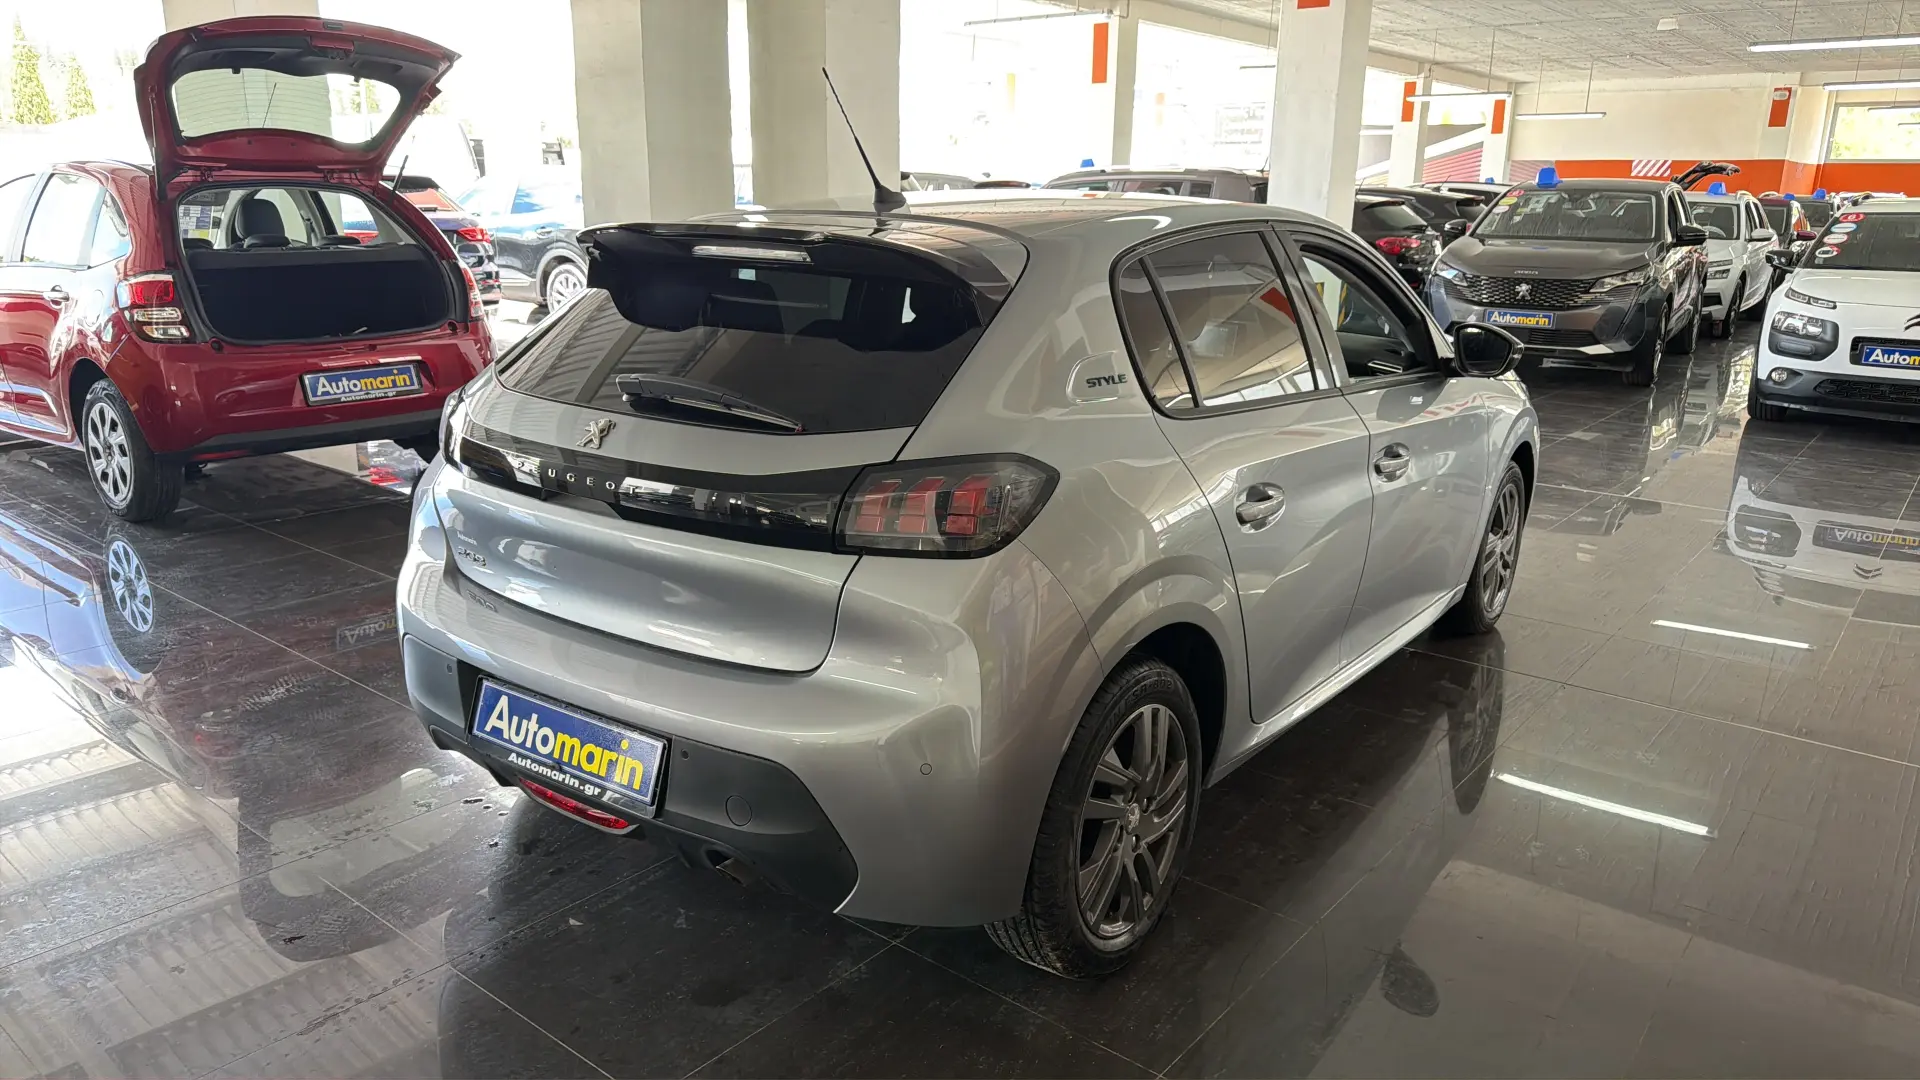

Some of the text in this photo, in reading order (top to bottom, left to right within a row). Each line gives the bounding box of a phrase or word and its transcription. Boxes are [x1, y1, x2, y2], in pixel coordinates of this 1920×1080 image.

[1490, 311, 1549, 326] Automarin
[317, 369, 411, 396] Automarin
[1086, 373, 1128, 388] STYLE
[341, 391, 397, 402] Automarin.gr
[516, 460, 638, 495] PEUGEOT
[484, 694, 644, 790] Automarin
[508, 752, 602, 797] Automarin.gr
